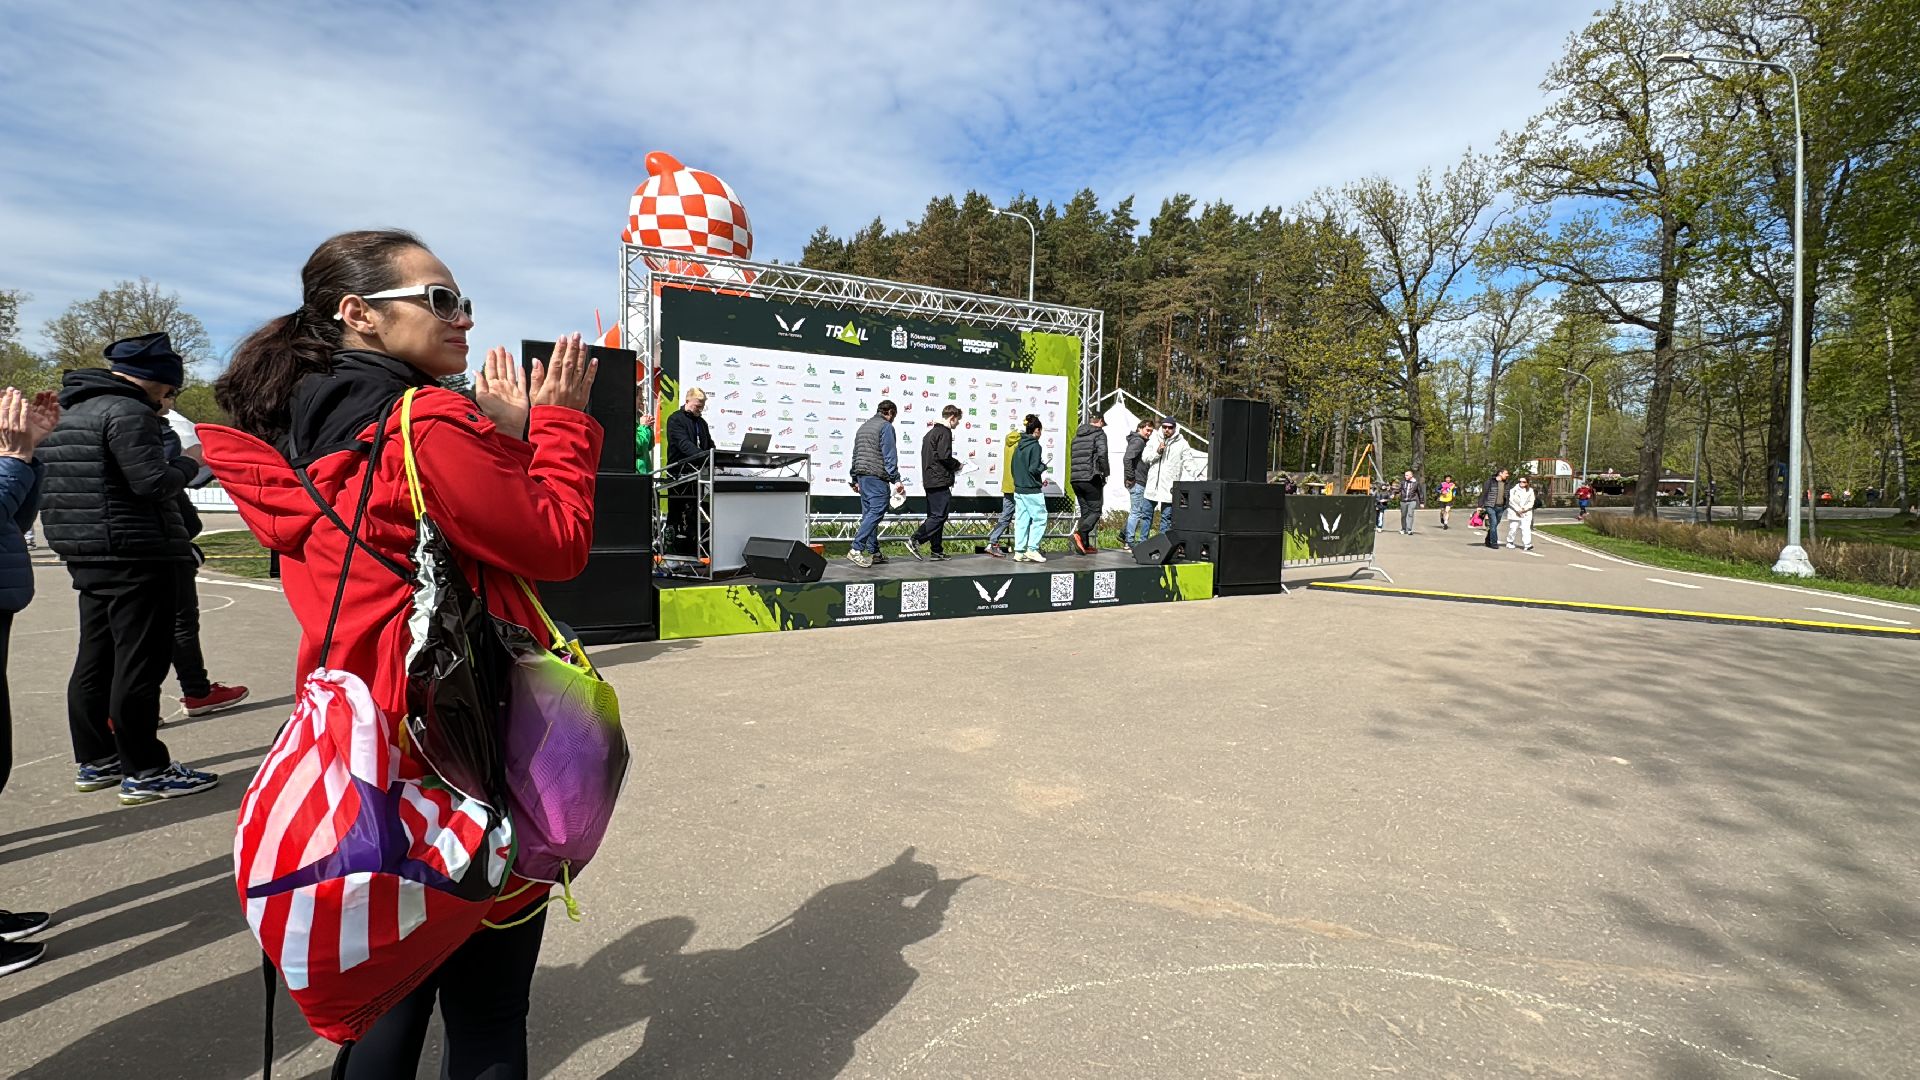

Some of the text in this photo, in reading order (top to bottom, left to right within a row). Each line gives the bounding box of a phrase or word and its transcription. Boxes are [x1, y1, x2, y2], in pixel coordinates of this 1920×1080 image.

[910, 332, 936, 342] Команда
[910, 340, 947, 351] Губернатора
[962, 346, 992, 355] СПОРТ
